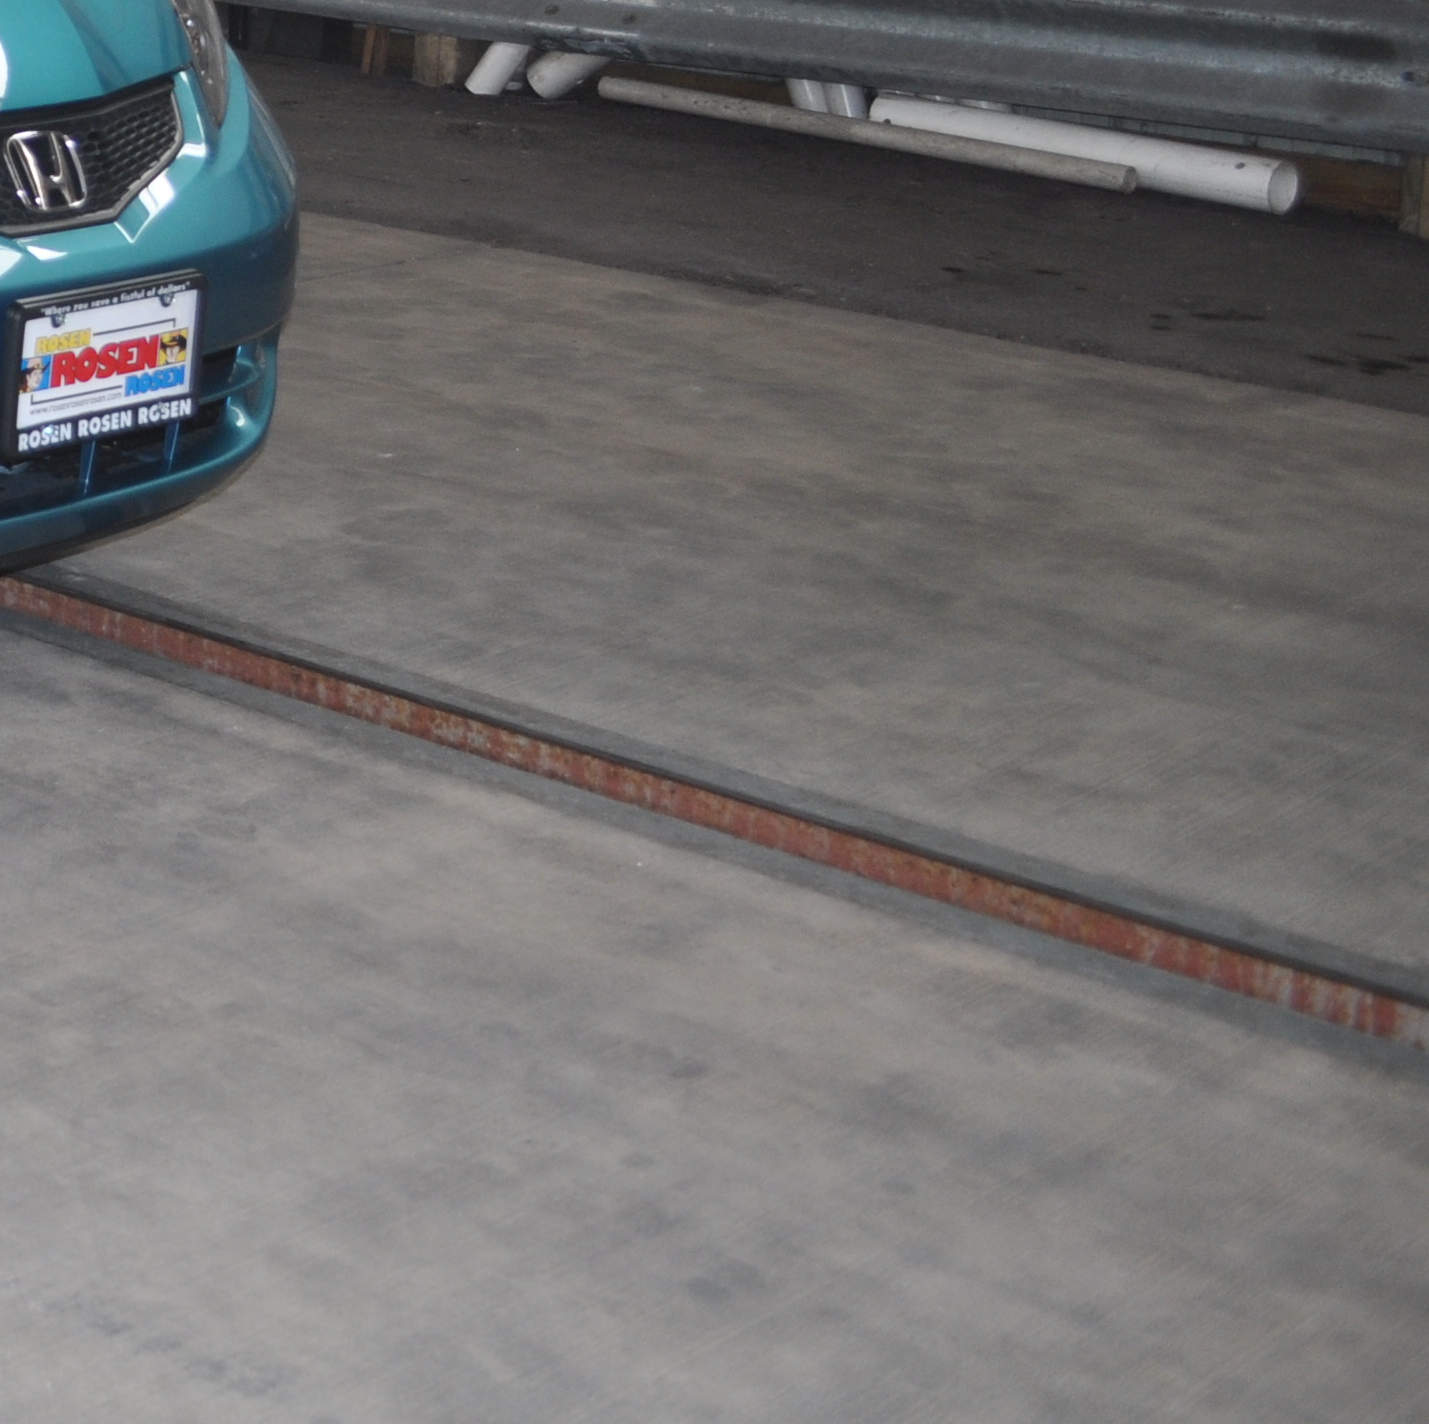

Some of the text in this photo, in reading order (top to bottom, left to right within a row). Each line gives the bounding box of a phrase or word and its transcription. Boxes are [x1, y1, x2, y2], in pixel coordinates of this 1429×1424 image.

[73, 302, 89, 312] you
[91, 298, 110, 308] save
[112, 296, 119, 305] a
[120, 289, 145, 302] fistful
[146, 287, 156, 297] of
[35, 328, 91, 355] ROSEN
[50, 334, 160, 388] ROSEN
[124, 364, 186, 398] ROSEN
[18, 398, 192, 452] ROSEN ROSEN ROSEN
